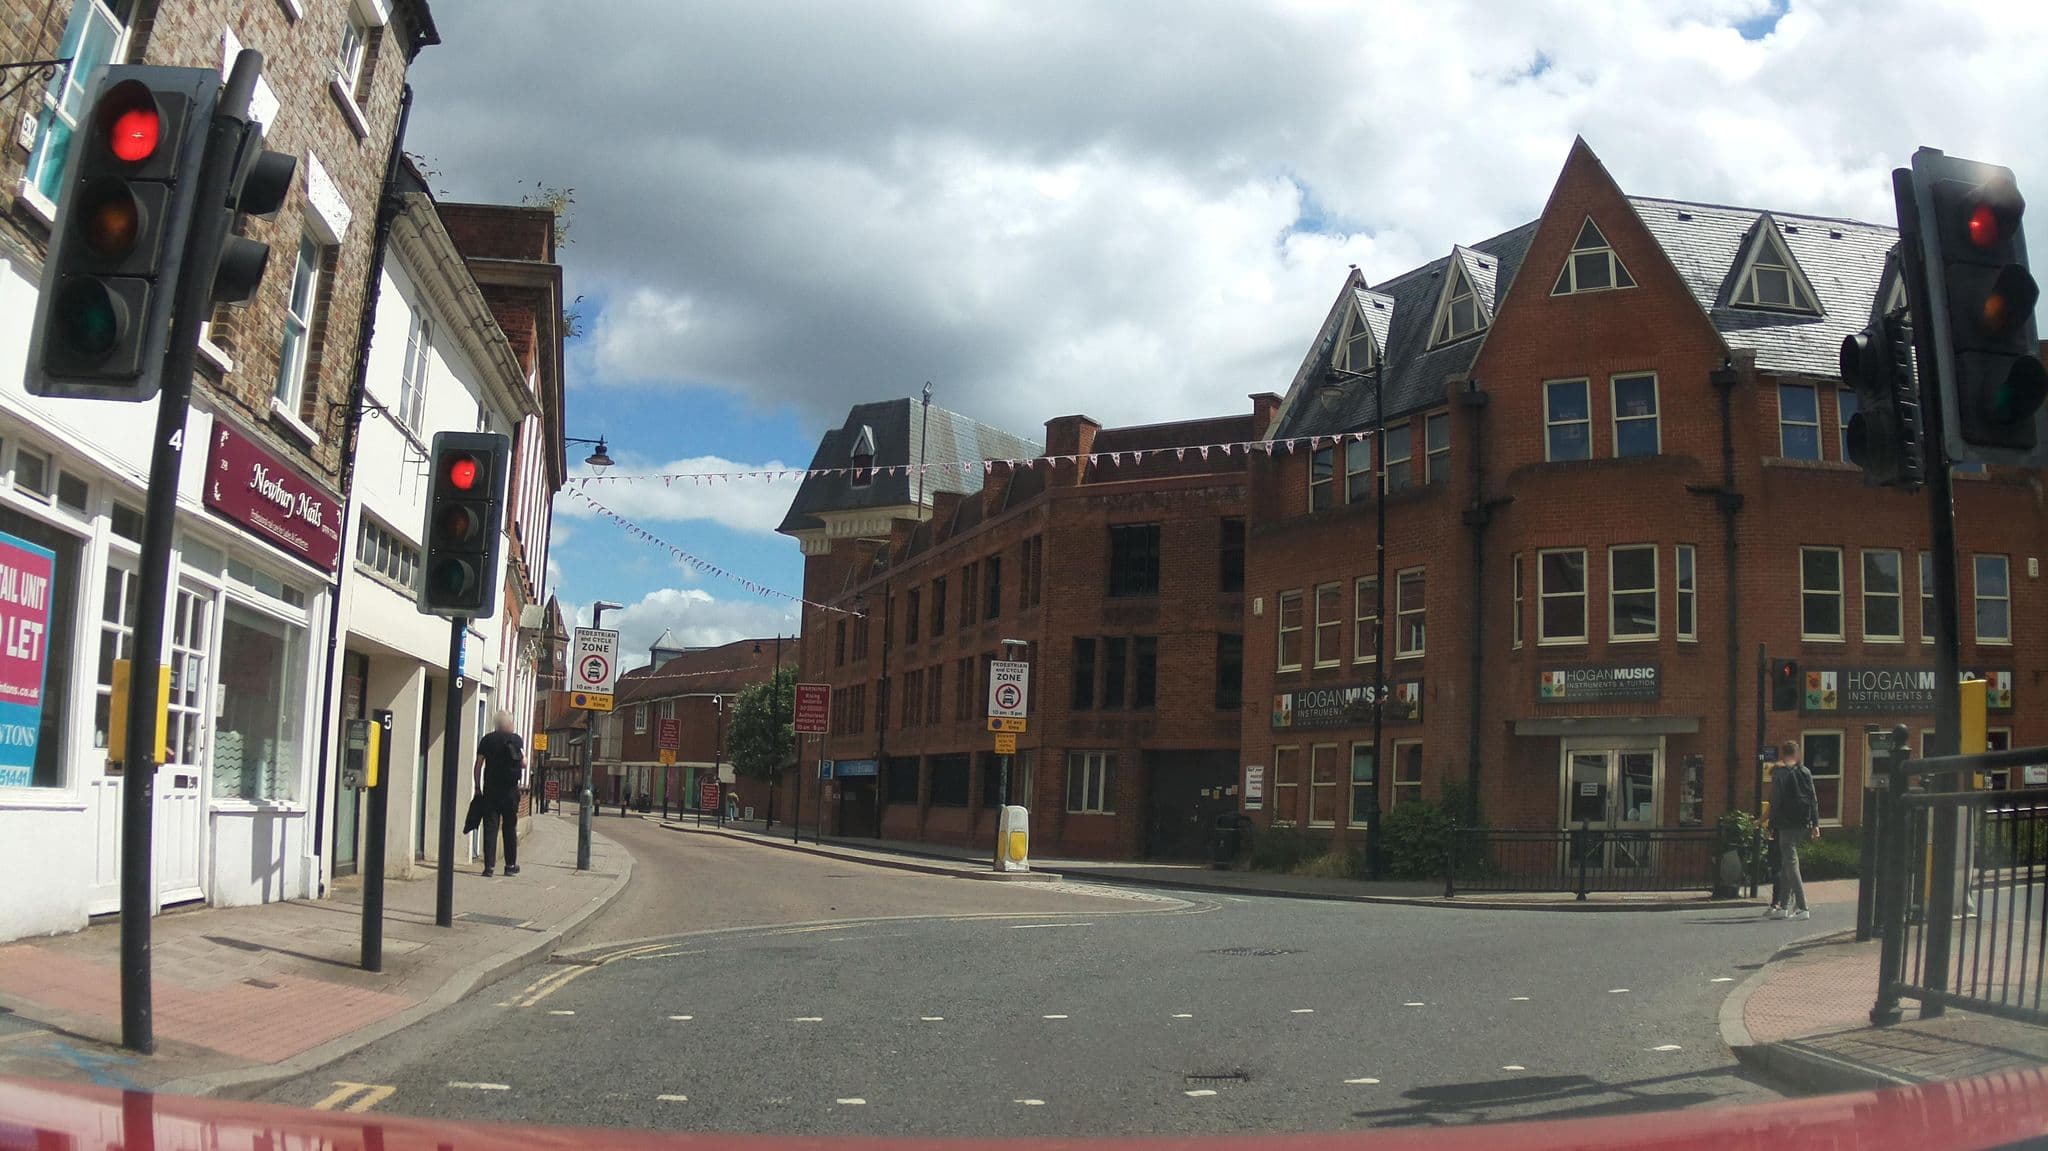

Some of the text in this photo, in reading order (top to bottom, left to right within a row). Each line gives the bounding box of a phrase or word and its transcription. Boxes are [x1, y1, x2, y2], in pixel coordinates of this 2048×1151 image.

[168, 429, 182, 451] 4
[250, 463, 322, 527] Newbury Nails
[21, 572, 48, 610] UNIT
[6, 616, 43, 661] LET
[578, 630, 616, 638] PEDESTRIAN
[582, 642, 609, 653] ZONE
[455, 676, 463, 689] 6
[997, 673, 1022, 682] ZONE
[1566, 680, 1617, 689] INSTRUMENTS
[1626, 680, 1656, 688] TUITION
[1848, 690, 1922, 701] INSTRUMENTS
[383, 714, 392, 730] 5
